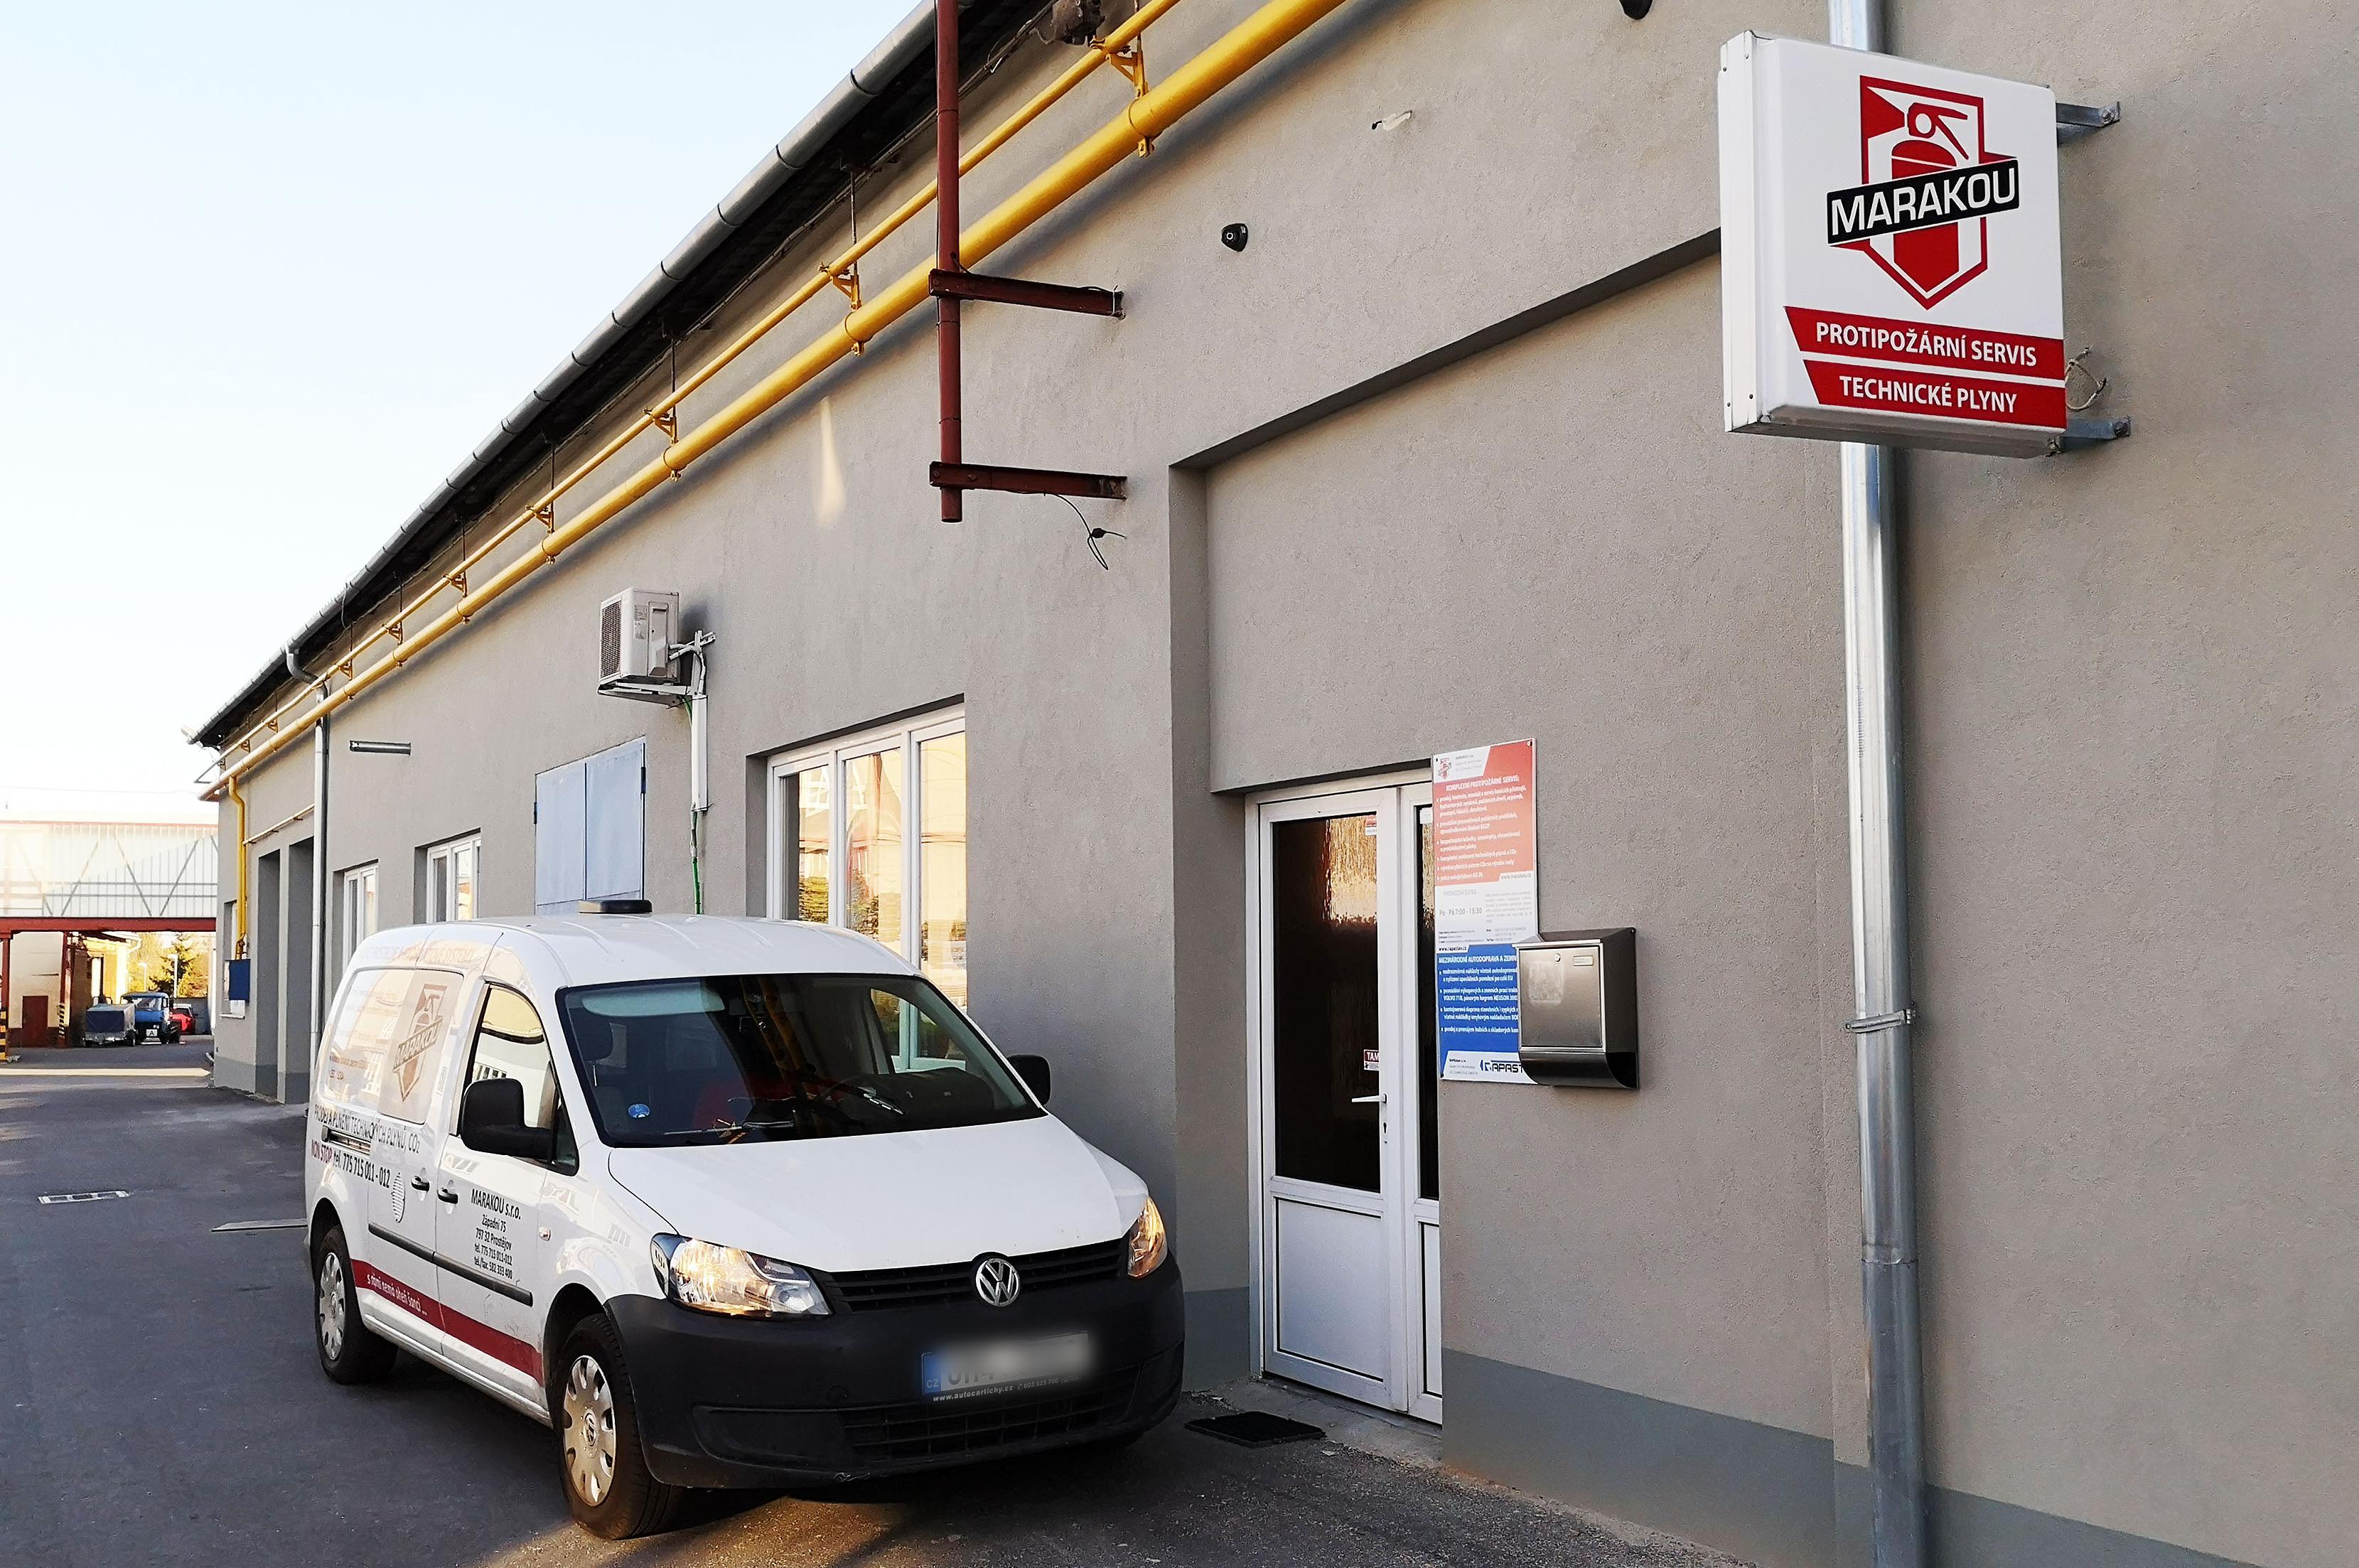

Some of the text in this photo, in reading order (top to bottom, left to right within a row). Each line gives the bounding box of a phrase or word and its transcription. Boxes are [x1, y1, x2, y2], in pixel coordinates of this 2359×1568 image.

[1832, 167, 2016, 236] MARAKOU
[1816, 322, 2036, 366] PROTIPOŽÁRNÍ SERVIS
[1839, 376, 2017, 414] TECHNICKÉ PLYNY
[1470, 776, 1502, 788] PROTIPOŽÁRNÍ
[1449, 908, 1454, 916] Pá
[321, 1144, 333, 1164] STOP
[343, 1152, 353, 1174] 775
[354, 1156, 364, 1178] 715
[364, 1160, 375, 1183] 011
[379, 1166, 390, 1188] 012
[471, 1188, 521, 1220] MARAKOU s.r.o.
[475, 1227, 512, 1252] 797 32 Prostějov
[500, 1220, 507, 1233] 75
[926, 1378, 939, 1390] CZ
